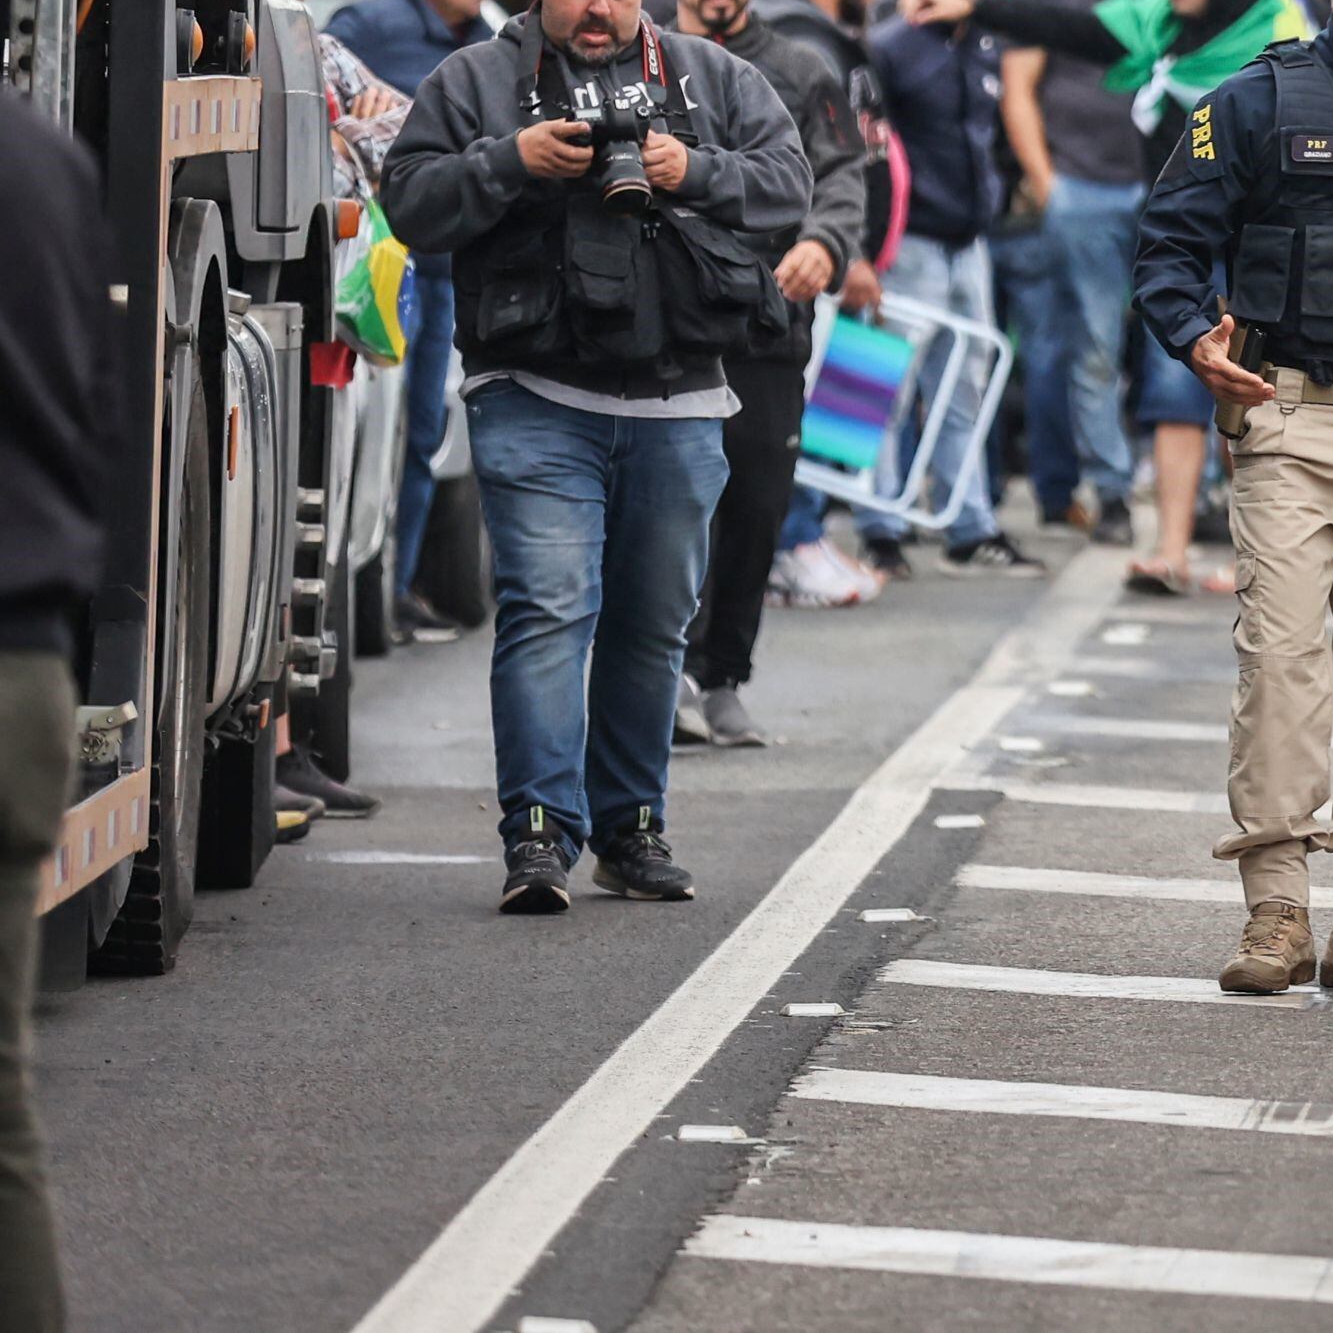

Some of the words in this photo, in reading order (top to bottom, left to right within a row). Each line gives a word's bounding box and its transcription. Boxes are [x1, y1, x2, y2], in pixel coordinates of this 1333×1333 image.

[648, 47, 658, 75] EOS
[1192, 104, 1216, 161] PRF
[1307, 140, 1328, 149] PRF
